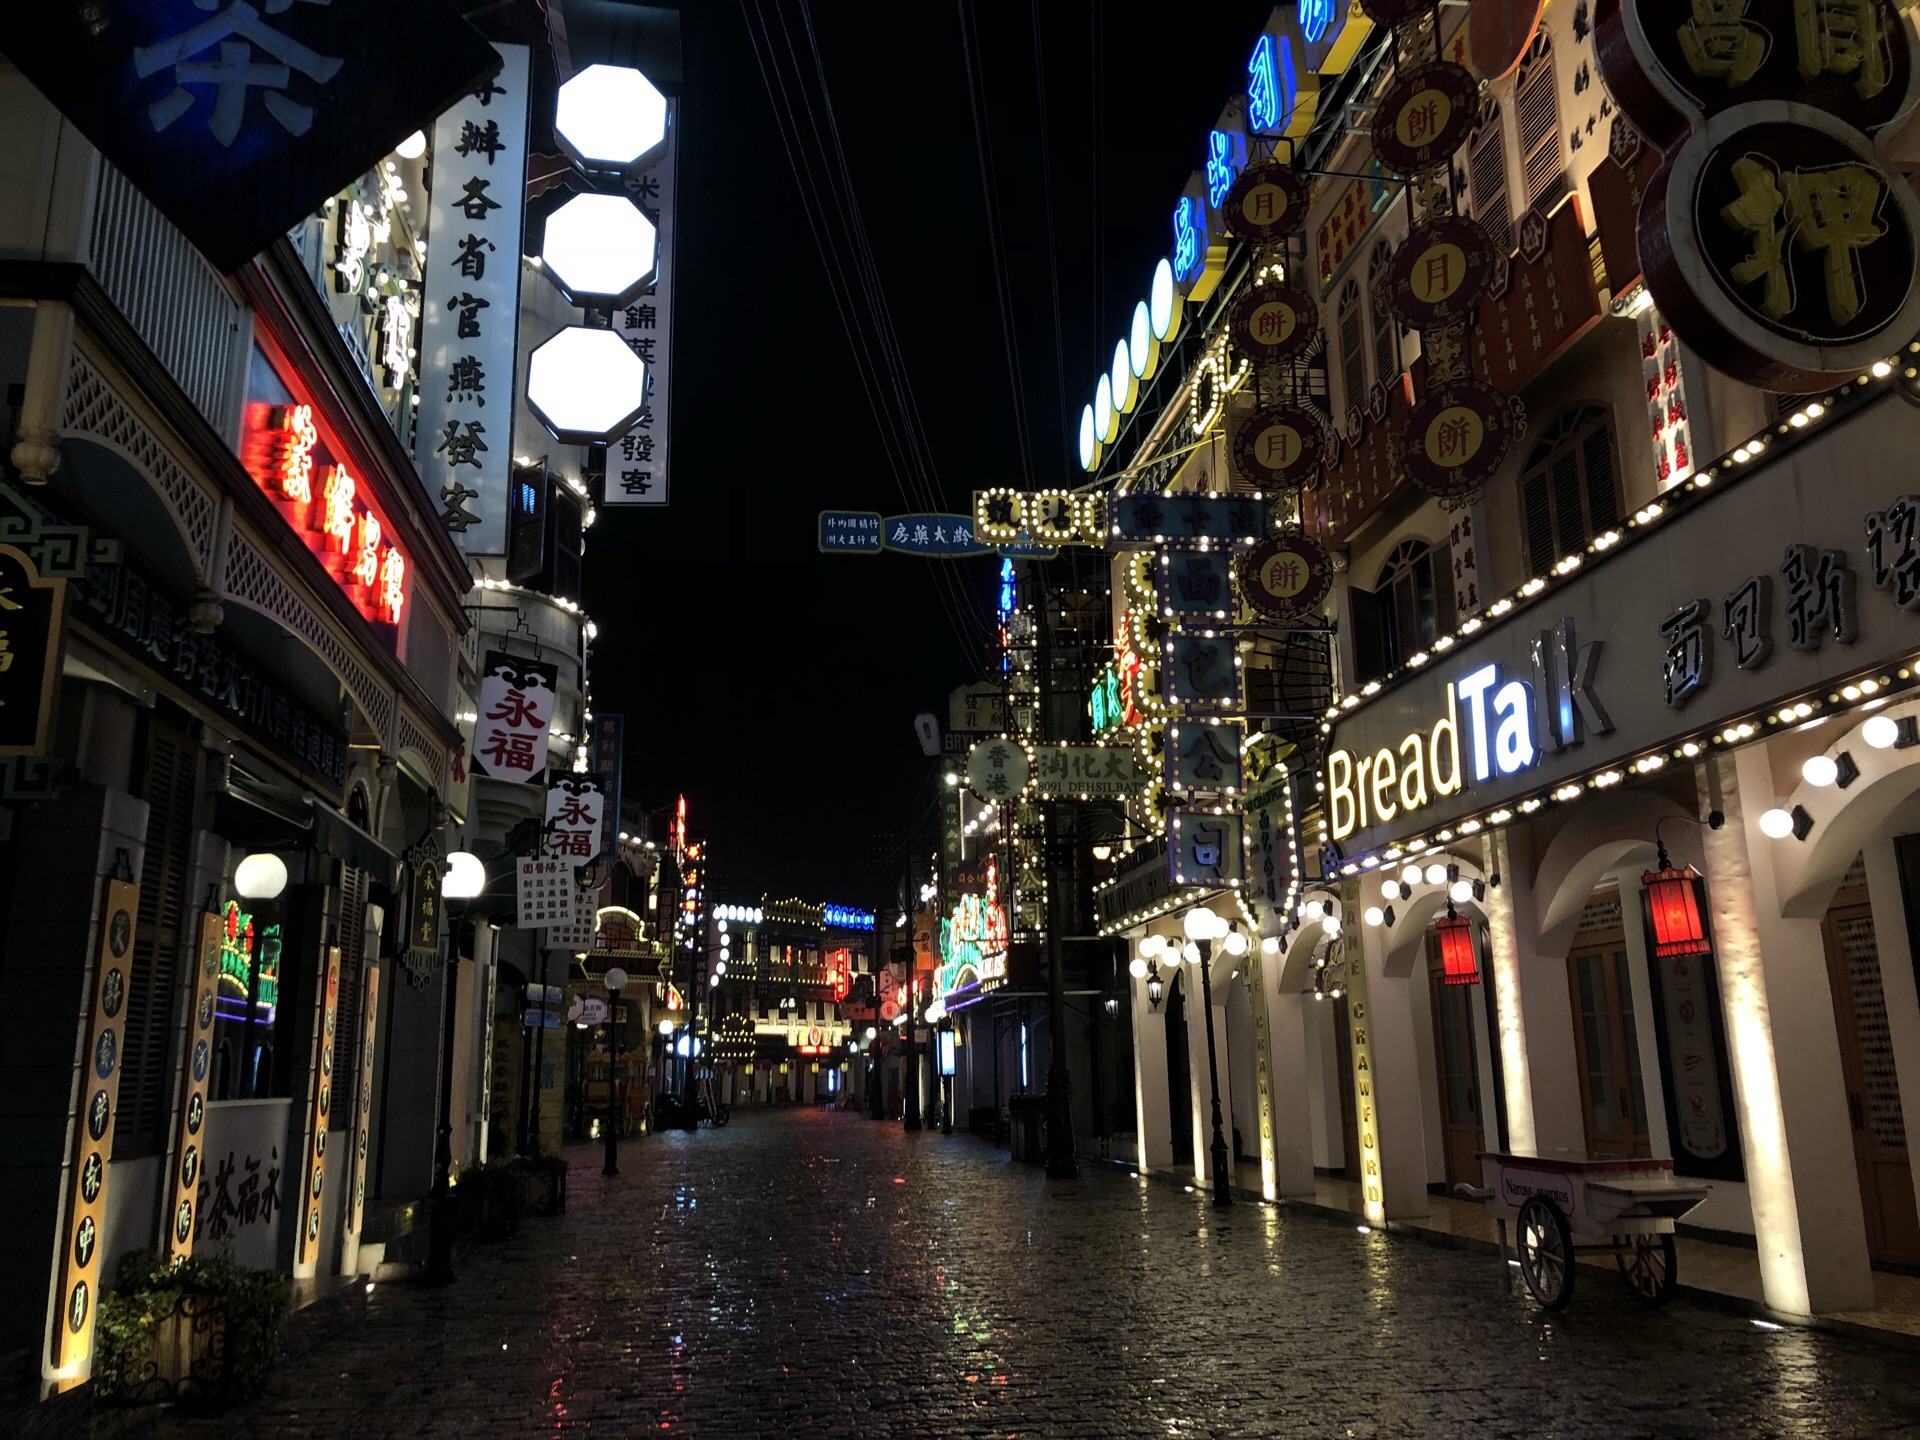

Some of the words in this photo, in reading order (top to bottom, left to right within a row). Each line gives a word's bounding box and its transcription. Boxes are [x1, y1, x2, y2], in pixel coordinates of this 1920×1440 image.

[1254, 192, 1274, 219] 月
[1426, 253, 1448, 298] 月
[1720, 157, 1880, 327] 押
[1265, 433, 1287, 462] 月
[481, 689, 546, 772] 永福
[1328, 617, 1613, 842] BreadTalk
[987, 745, 1011, 796] 香港
[554, 796, 597, 857] 永福
[420, 869, 435, 942] 永福堂
[1353, 1002, 1380, 1203] CRAWFORD
